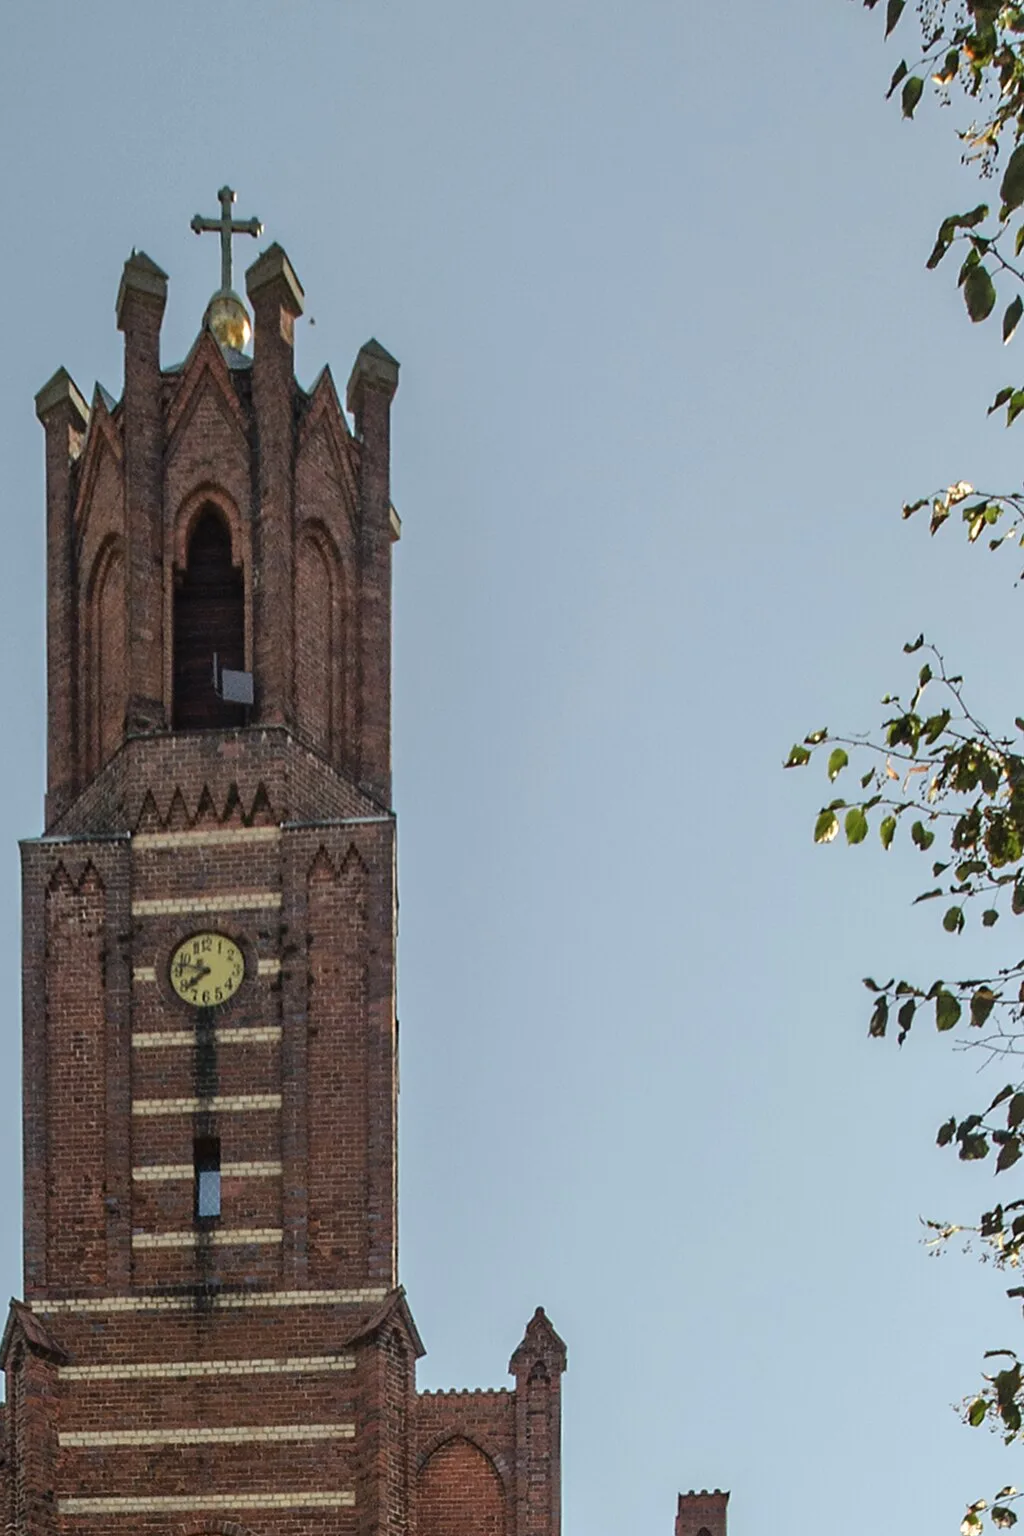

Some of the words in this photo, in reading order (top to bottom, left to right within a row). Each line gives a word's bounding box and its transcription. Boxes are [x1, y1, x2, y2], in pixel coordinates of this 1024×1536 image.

[180, 952, 191, 965] 10
[227, 948, 235, 961] 2
[175, 965, 183, 978] 9
[231, 963, 241, 977] 3
[180, 979, 189, 993] 8
[224, 977, 233, 991] 4
[191, 988, 198, 1002] 7
[202, 990, 211, 1003] 6
[215, 987, 223, 1001] 5
